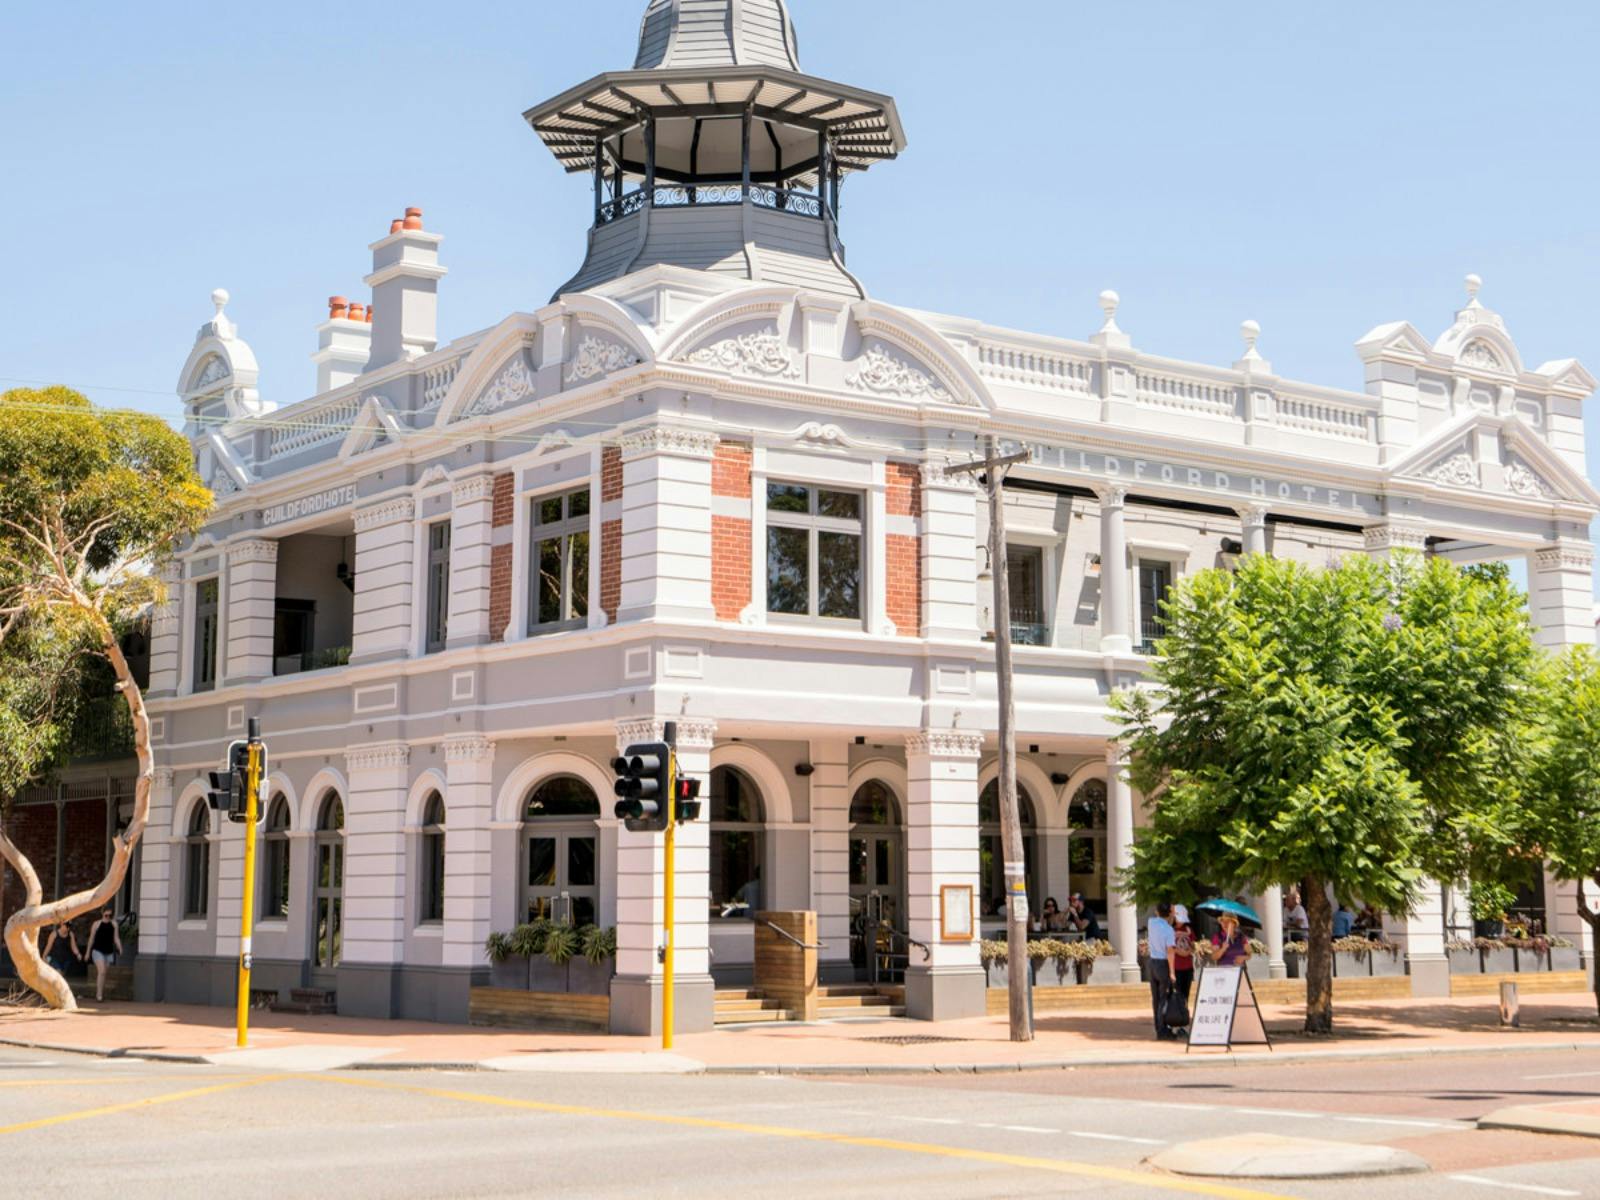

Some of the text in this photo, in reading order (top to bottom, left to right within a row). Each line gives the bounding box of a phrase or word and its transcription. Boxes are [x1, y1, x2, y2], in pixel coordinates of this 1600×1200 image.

[1000, 440, 1366, 511] GUILDFORD HOTEL
[263, 483, 359, 525] GUILDFORD HOTEL
